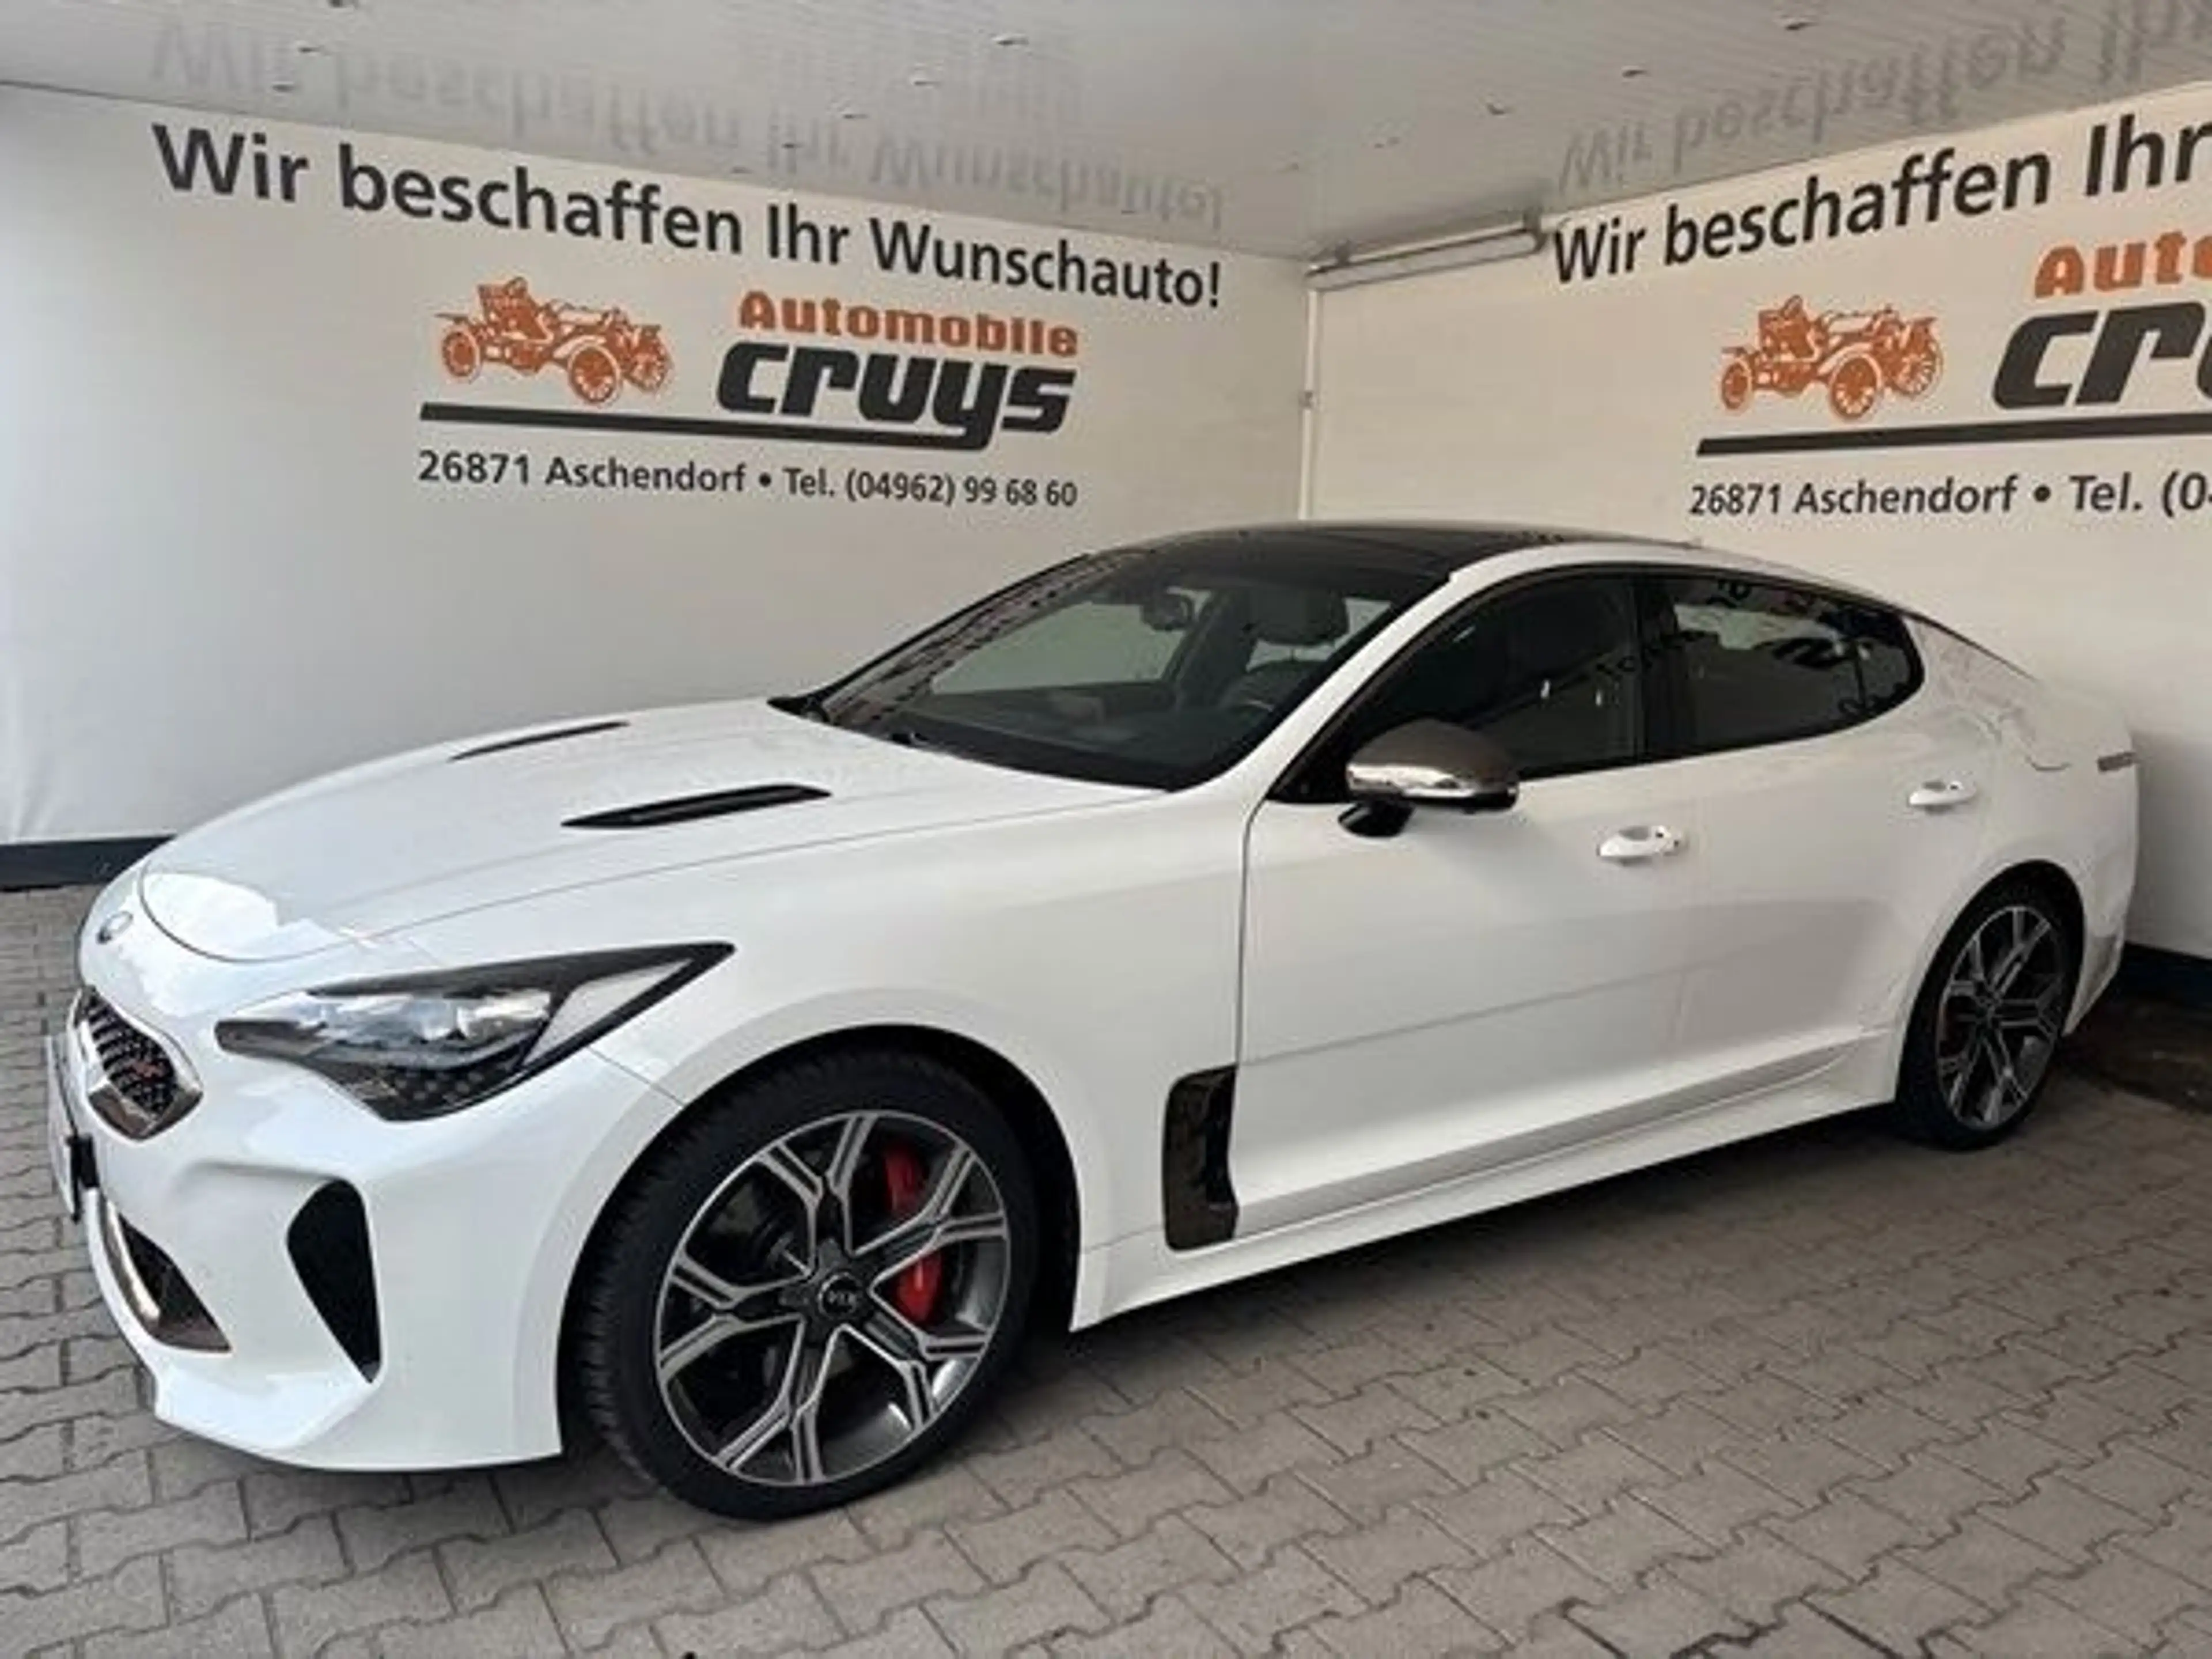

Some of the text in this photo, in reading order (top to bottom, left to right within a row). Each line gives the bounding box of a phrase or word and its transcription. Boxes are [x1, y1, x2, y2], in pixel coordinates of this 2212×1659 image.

[151, 123, 1221, 309] Wir beschaffen Ihr Wunschauto!
[1554, 113, 2212, 283] Wir beschaffen Ihr
[740, 290, 1077, 358] Automobile
[419, 449, 1078, 508] 26871 Aschendorf Tel. (04962) 99 68 60
[1689, 469, 2212, 518] 26871 Aschendorf Tel. (0
